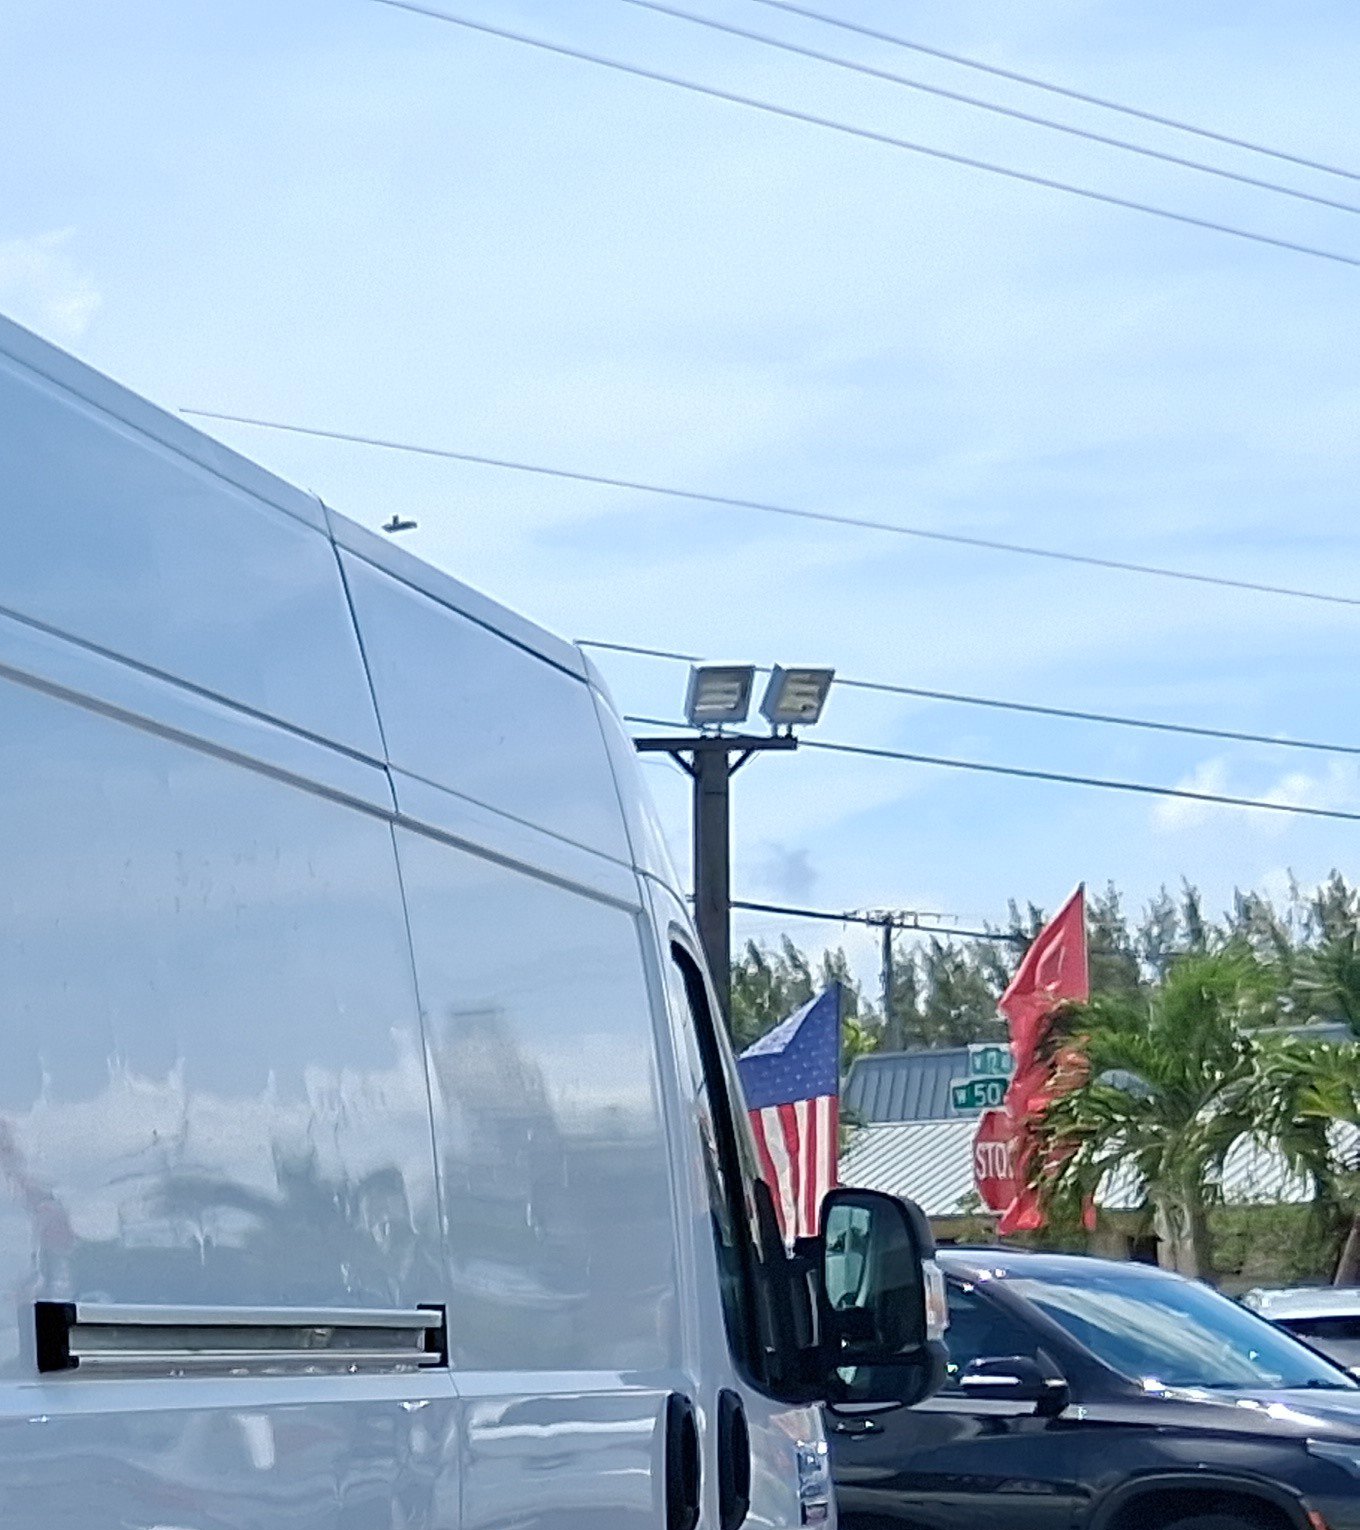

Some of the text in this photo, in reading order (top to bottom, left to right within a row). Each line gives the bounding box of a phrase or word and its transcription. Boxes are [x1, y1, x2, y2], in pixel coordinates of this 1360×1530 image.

[955, 1082, 1001, 1107] W 50
[975, 1141, 1015, 1181] STO
